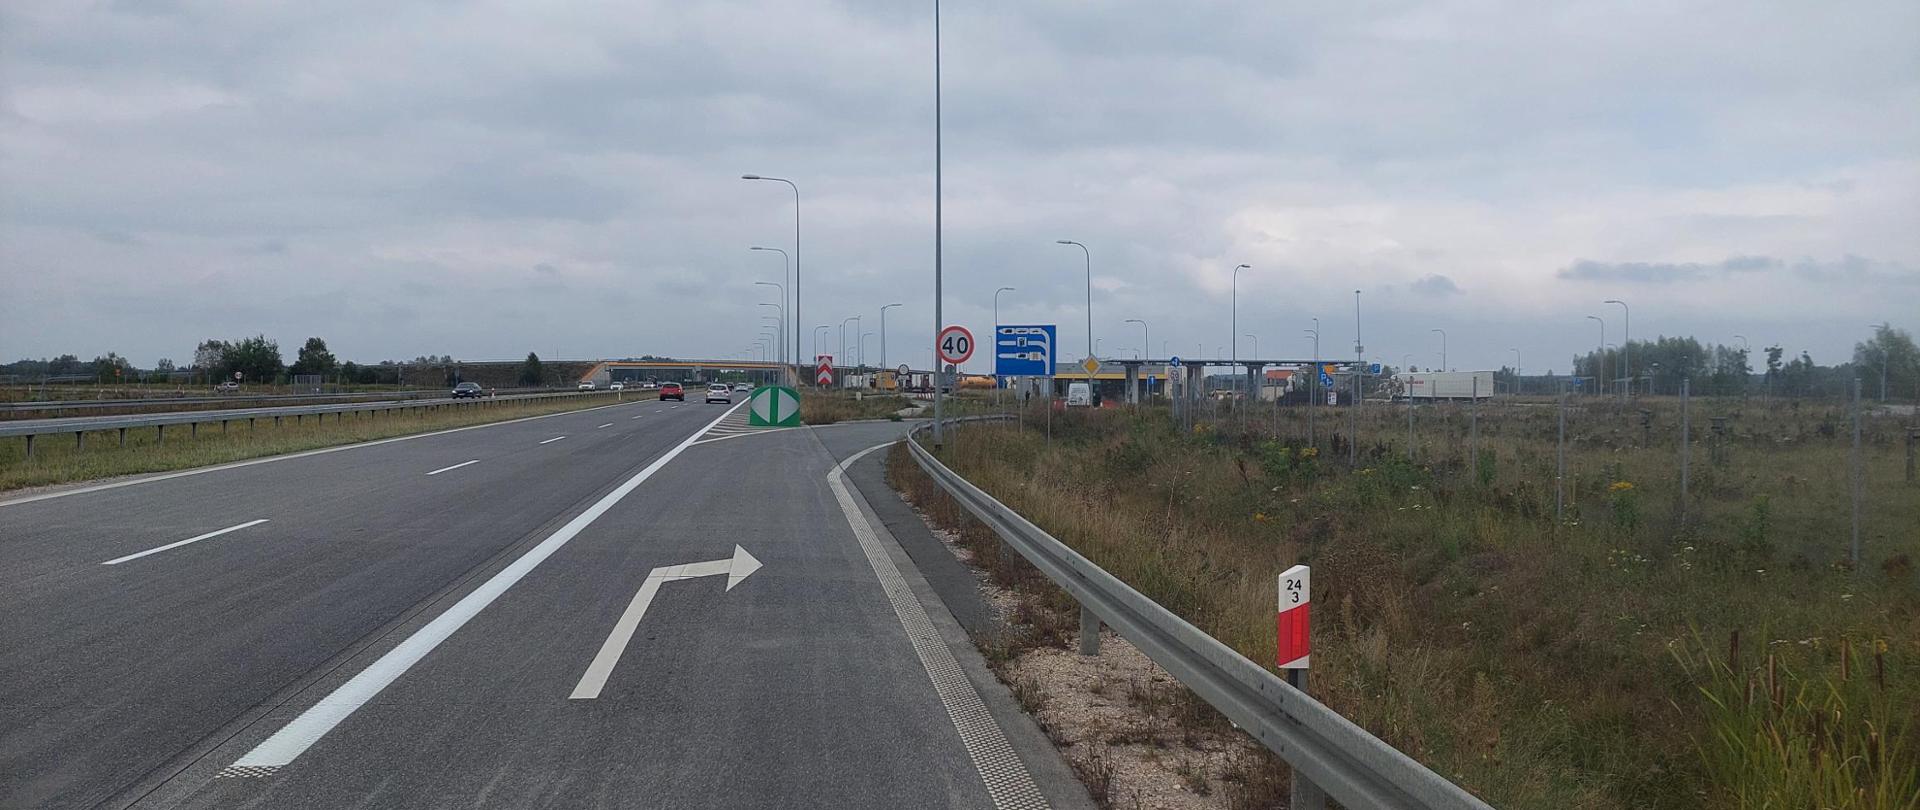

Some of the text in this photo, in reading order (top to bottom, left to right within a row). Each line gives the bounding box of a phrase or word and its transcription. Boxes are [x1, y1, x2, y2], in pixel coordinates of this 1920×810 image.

[942, 336, 969, 354] 40
[1286, 579, 1302, 591] 24
[1291, 591, 1300, 603] 3
